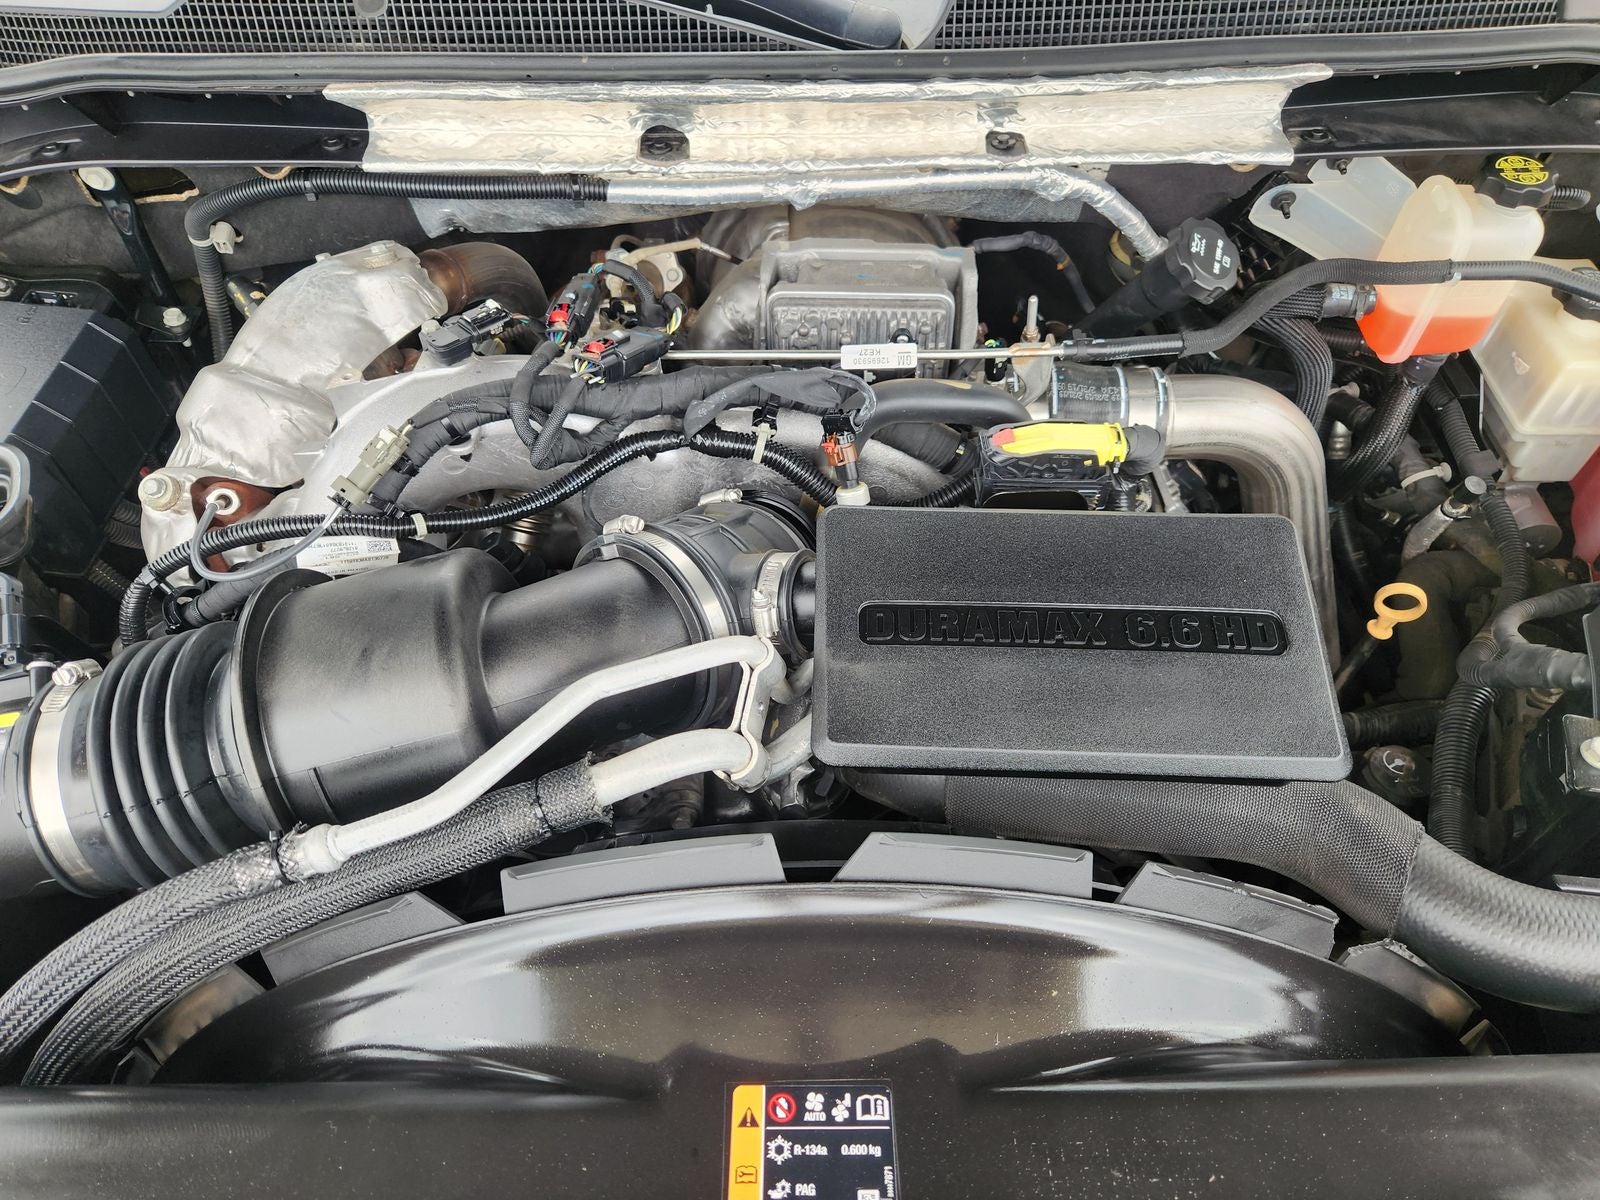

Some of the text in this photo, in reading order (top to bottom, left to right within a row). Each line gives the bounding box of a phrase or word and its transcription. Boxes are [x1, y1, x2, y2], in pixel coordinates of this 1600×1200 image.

[898, 355, 912, 366] GM
[866, 606, 1280, 651] DURAMAX 6.6 HD
[804, 1111, 827, 1122] AUTO
[793, 1144, 882, 1158] R-134a 0.600 kg
[795, 1183, 817, 1196] PAG
